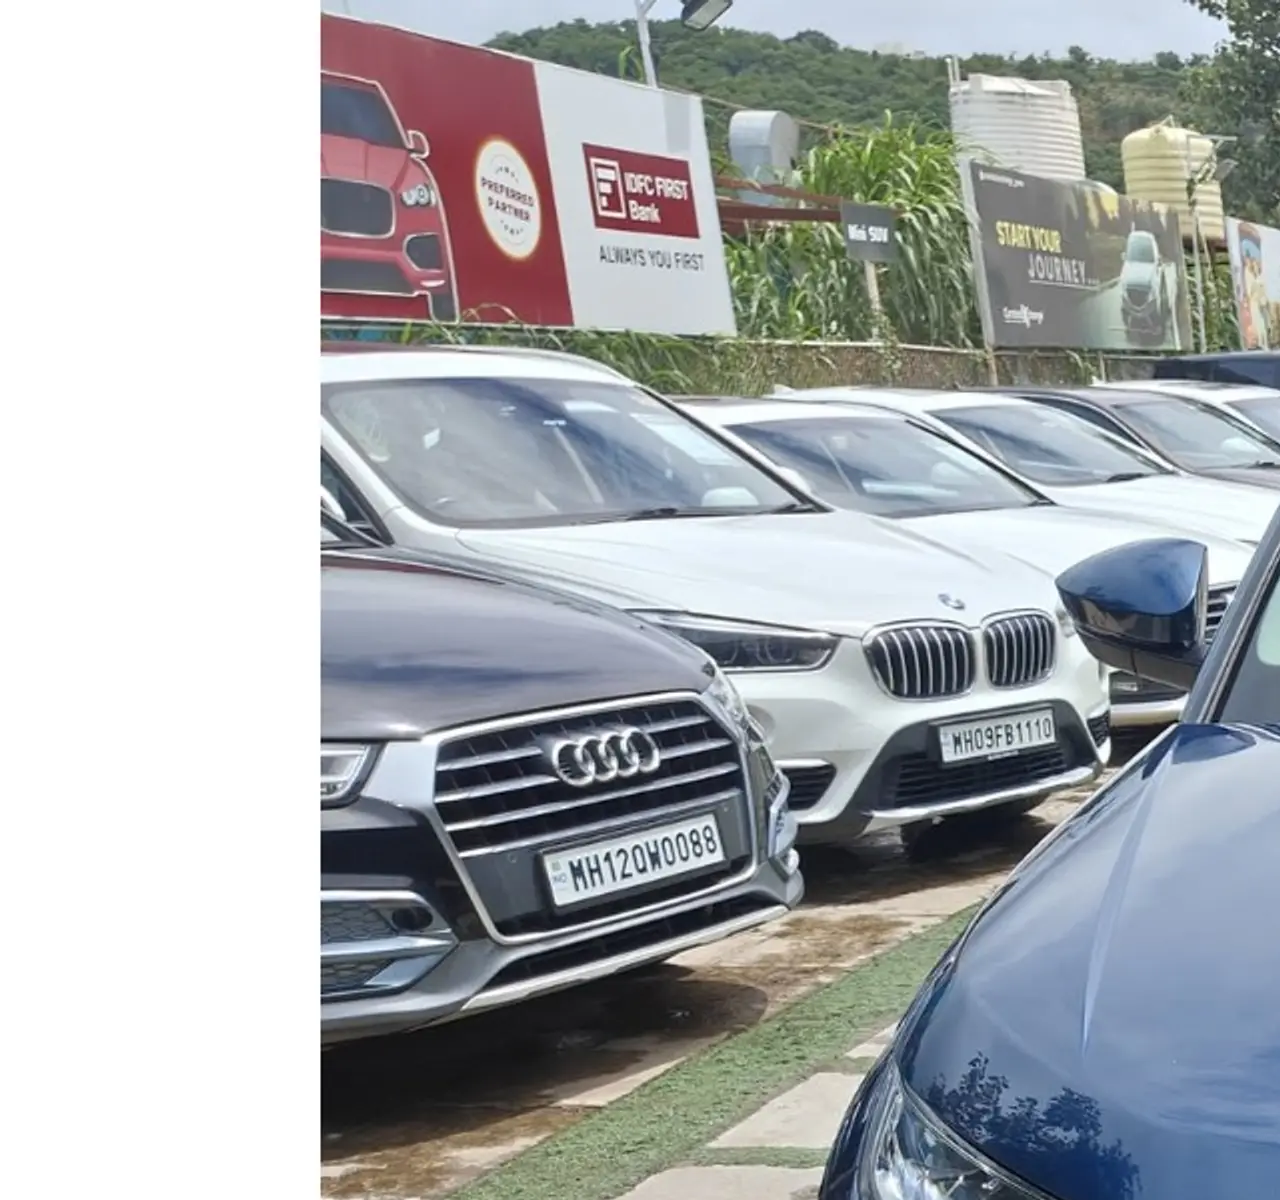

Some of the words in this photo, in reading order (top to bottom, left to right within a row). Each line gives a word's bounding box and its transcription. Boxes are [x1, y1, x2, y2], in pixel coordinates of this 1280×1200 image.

[480, 176, 535, 207] PREFERRED
[624, 172, 655, 196] IDFC
[654, 176, 688, 200] FIRST
[487, 196, 531, 221] PARTNER
[628, 200, 661, 224] Bank
[995, 220, 1032, 249] START
[1031, 226, 1062, 253] YOUR
[599, 245, 647, 267] ALWAYS
[648, 249, 672, 269] YOU
[674, 251, 704, 271] FIRST
[951, 718, 1052, 756] MH09FB1110
[568, 825, 718, 893] MH12QW0088
